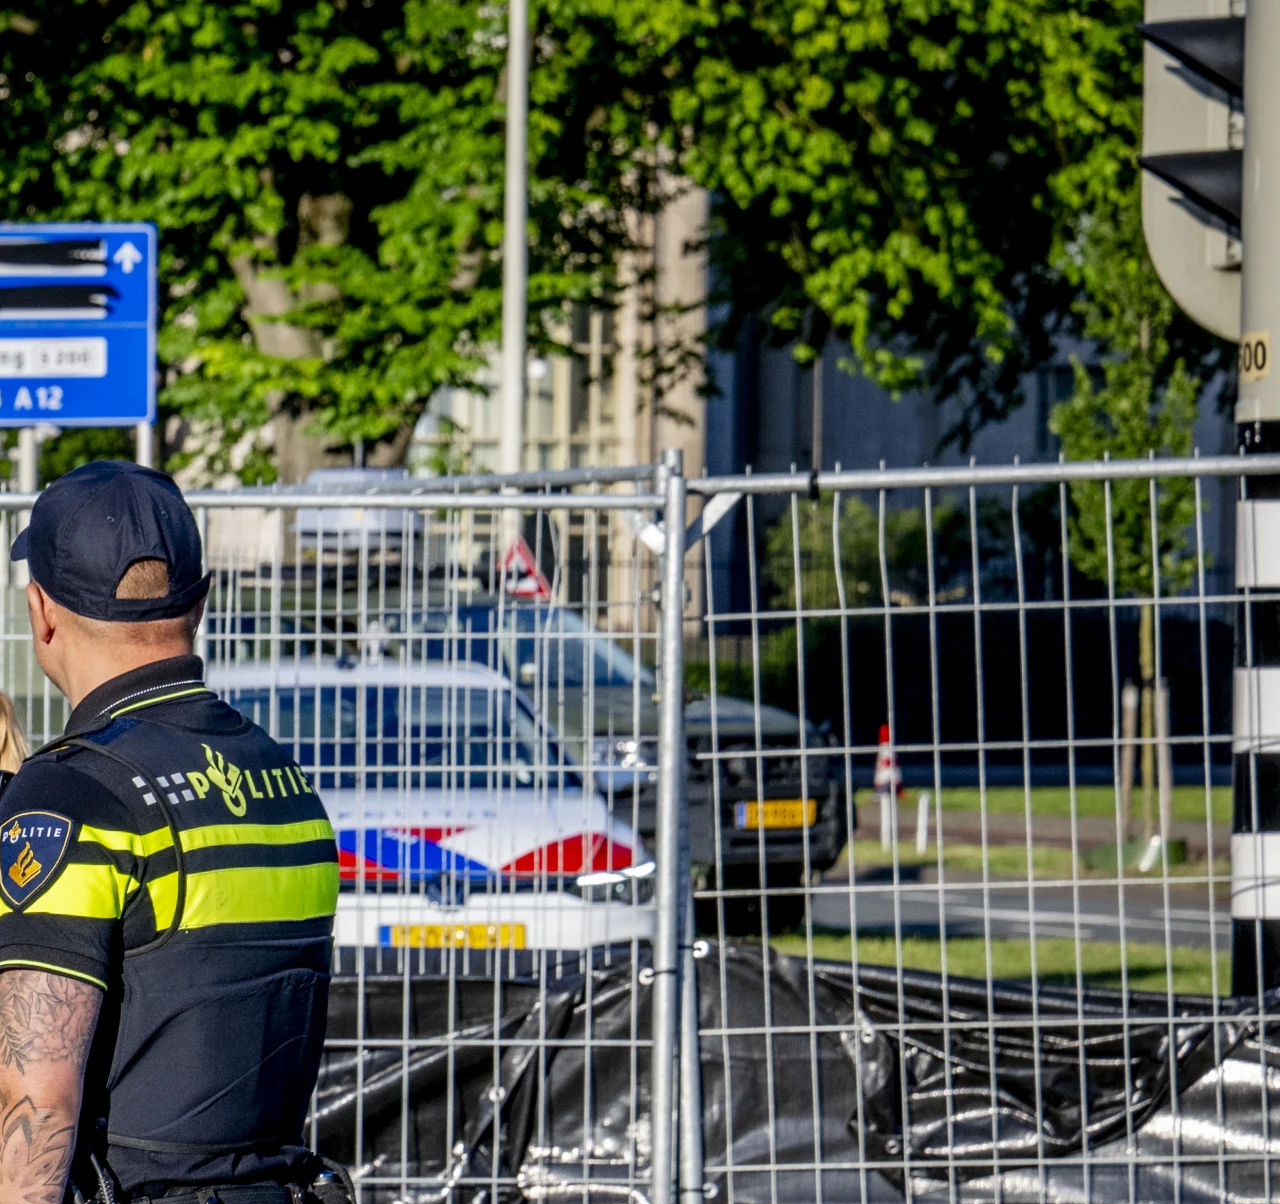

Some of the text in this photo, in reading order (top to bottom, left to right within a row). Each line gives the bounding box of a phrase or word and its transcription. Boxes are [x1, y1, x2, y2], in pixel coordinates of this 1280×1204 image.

[1239, 341, 1266, 372] 00
[186, 747, 313, 817] POLITIE
[2, 824, 62, 843] POLITIE
